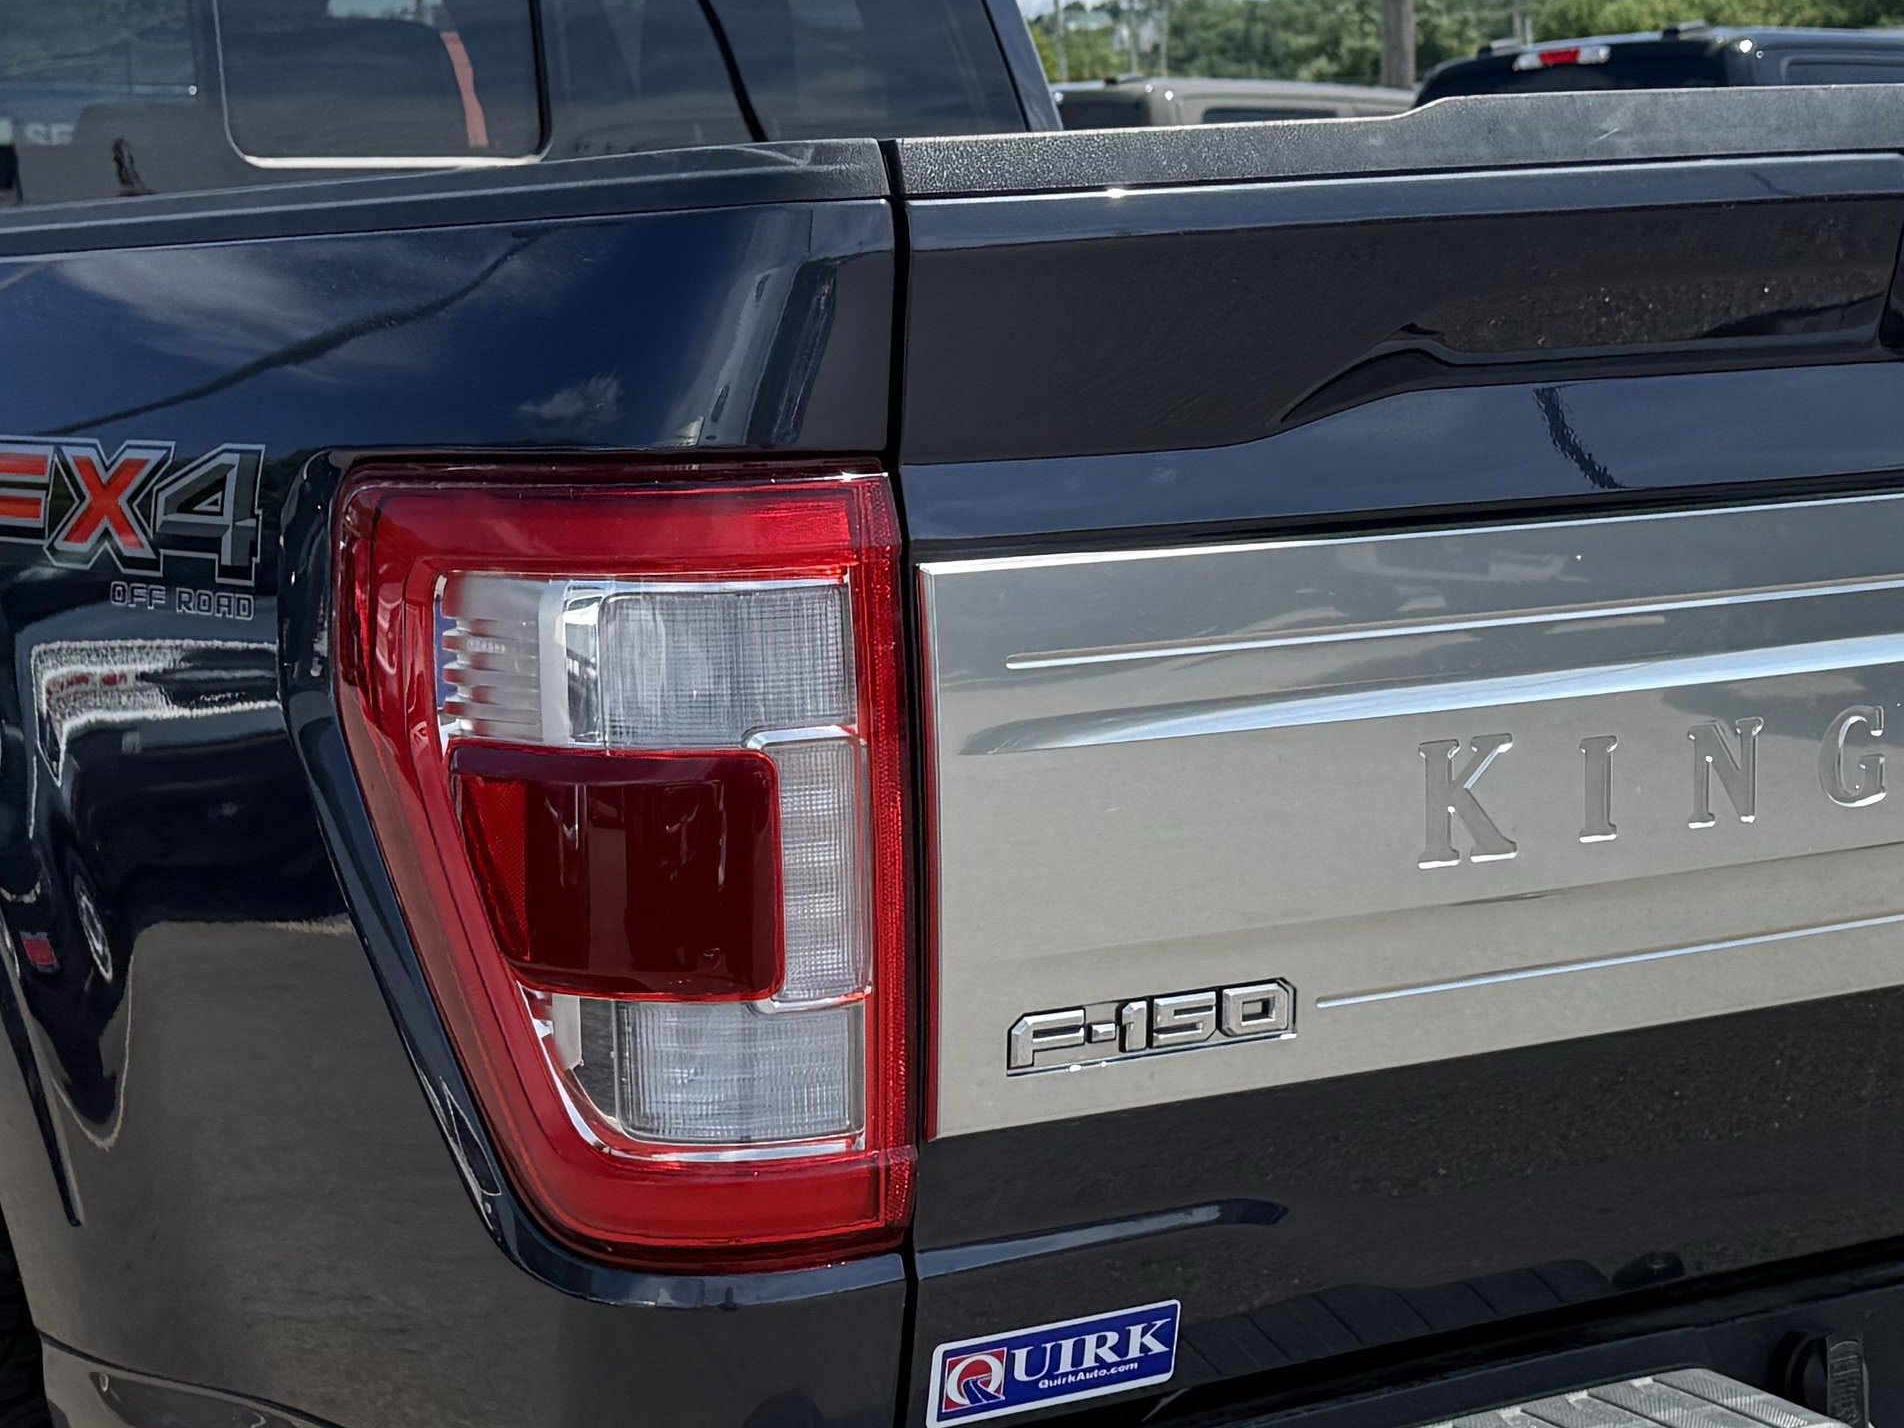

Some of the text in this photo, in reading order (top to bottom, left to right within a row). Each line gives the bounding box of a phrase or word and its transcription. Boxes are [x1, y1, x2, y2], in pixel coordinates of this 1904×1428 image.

[109, 580, 256, 621] OFF ROAD
[1417, 704, 1887, 870] KING
[1006, 976, 1298, 1076] F-150
[944, 1317, 1173, 1406] QUIRK
[1037, 1360, 1139, 1390] QuirkAuto.com
